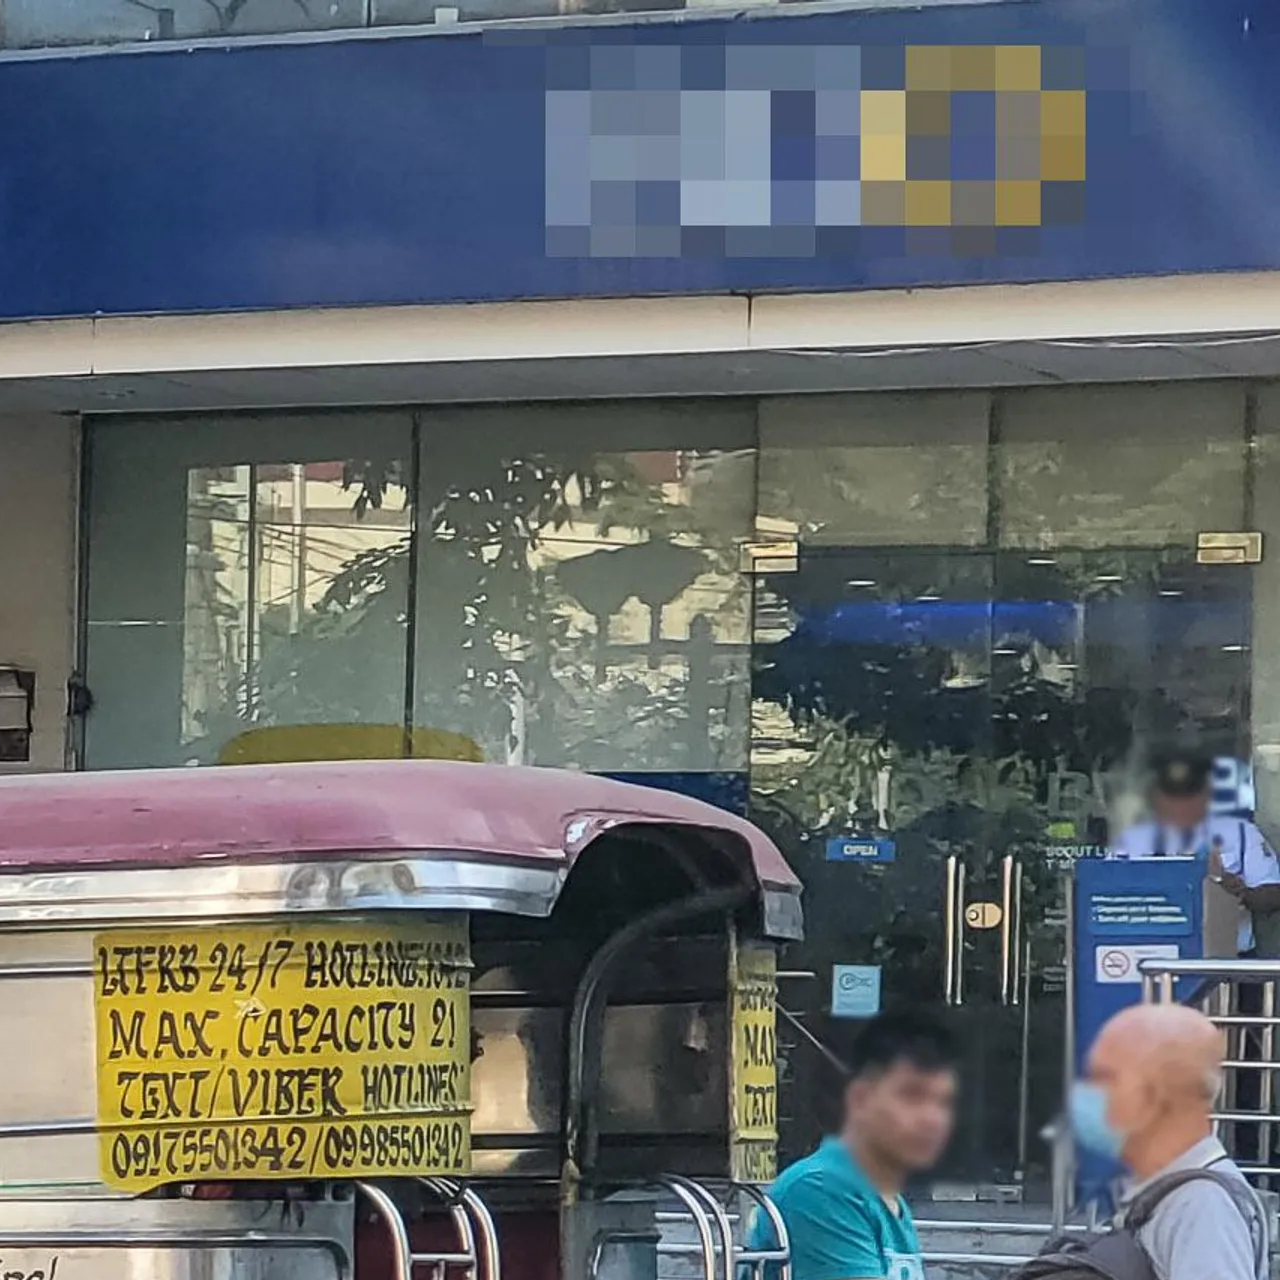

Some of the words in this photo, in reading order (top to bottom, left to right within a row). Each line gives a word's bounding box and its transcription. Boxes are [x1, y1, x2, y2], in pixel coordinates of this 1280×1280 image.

[843, 845, 879, 857] OPEN
[97, 942, 199, 997] LTFRB
[208, 940, 295, 996] 24/7
[236, 1000, 416, 1059] CAPACITY
